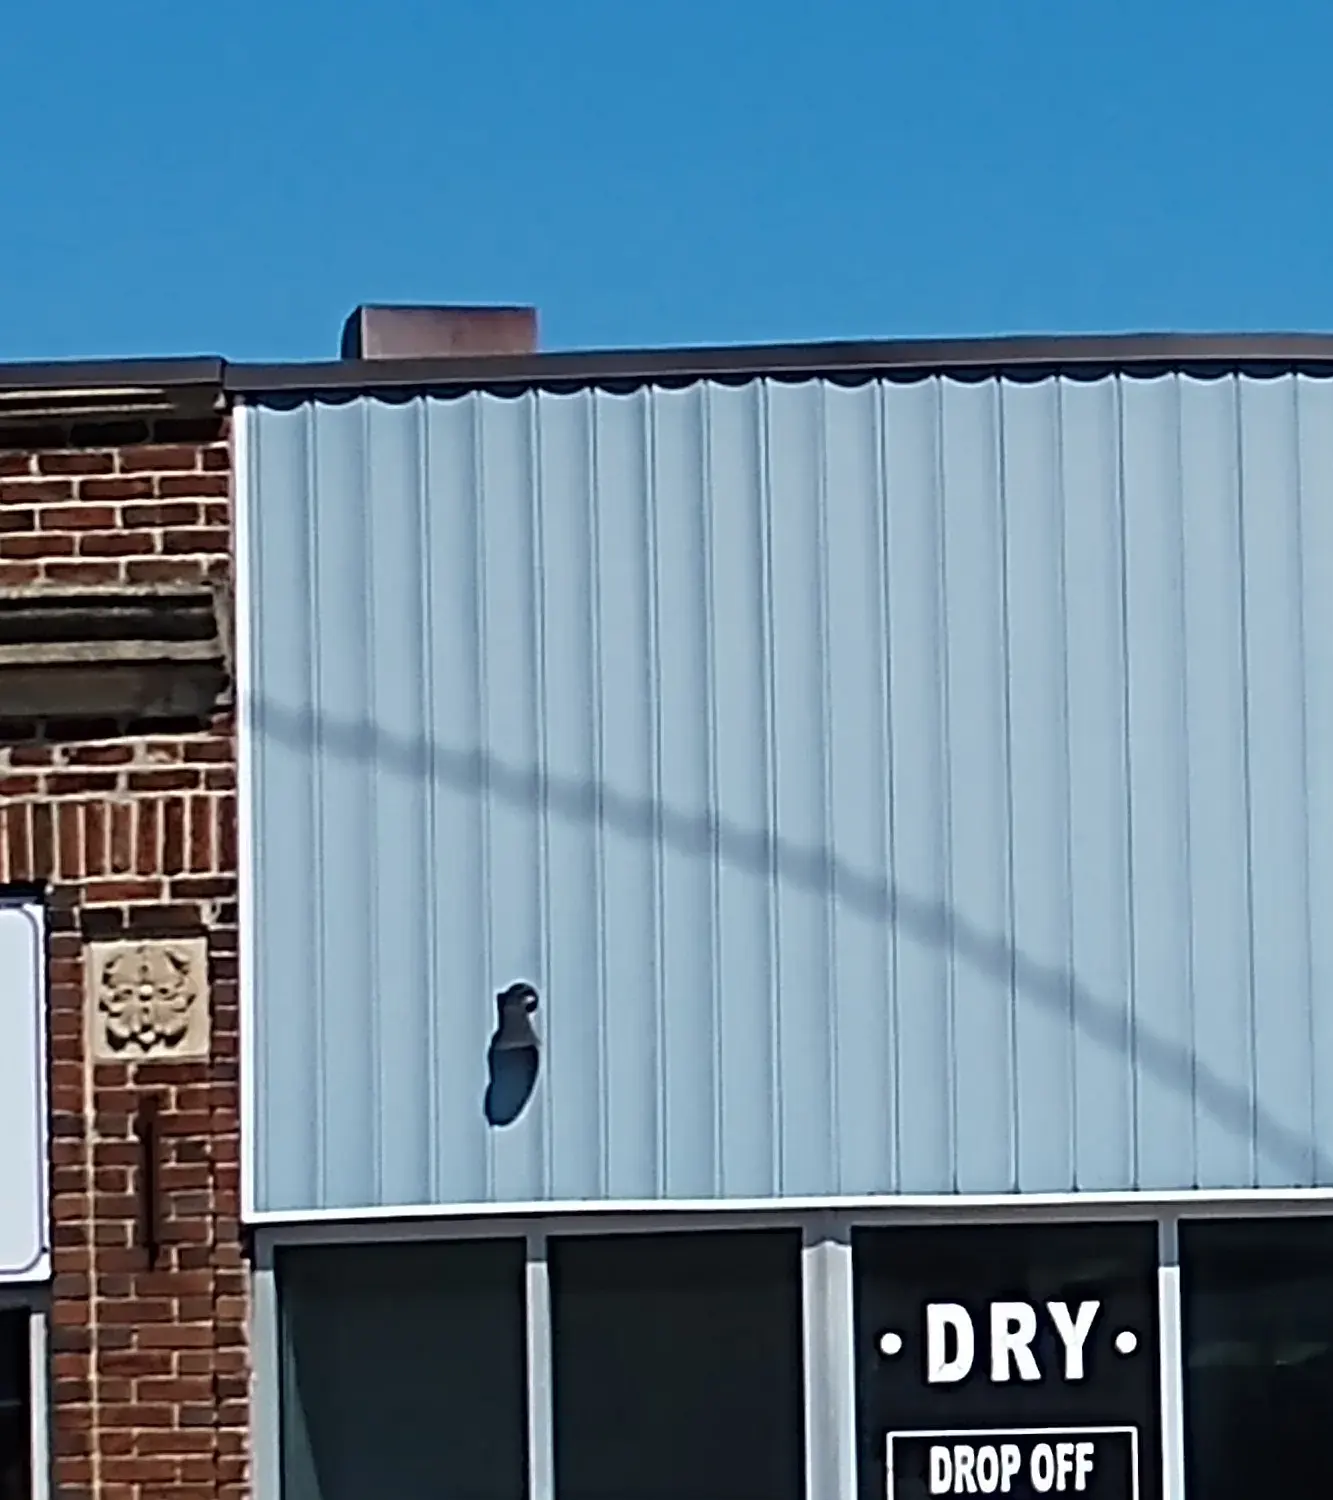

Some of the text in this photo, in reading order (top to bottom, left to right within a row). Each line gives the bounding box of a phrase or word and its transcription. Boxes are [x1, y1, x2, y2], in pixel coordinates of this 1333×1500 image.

[926, 1300, 1100, 1384] DRY
[929, 1442, 1095, 1495] DROP OFF
